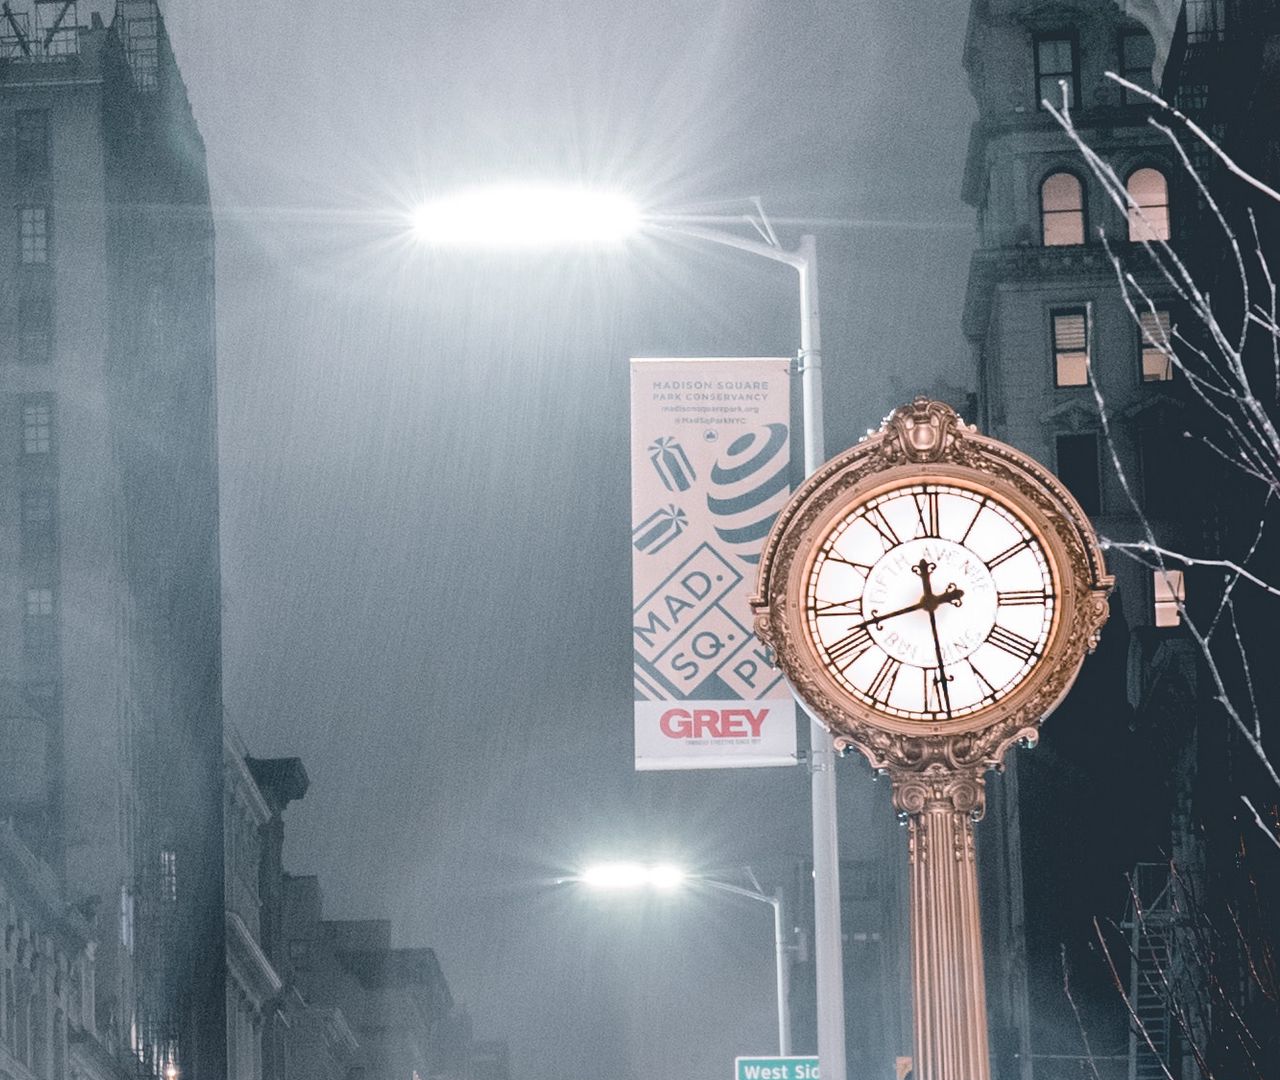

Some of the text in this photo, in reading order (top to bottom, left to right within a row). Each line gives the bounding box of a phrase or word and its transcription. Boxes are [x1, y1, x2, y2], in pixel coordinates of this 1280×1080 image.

[652, 381, 769, 390] MADISON SQUARE
[652, 393, 769, 401] PARK CONSERVANCY
[633, 571, 724, 648] MAD.
[670, 631, 735, 681] SQ.
[659, 708, 770, 739] GREY
[744, 1064, 789, 1080] West
